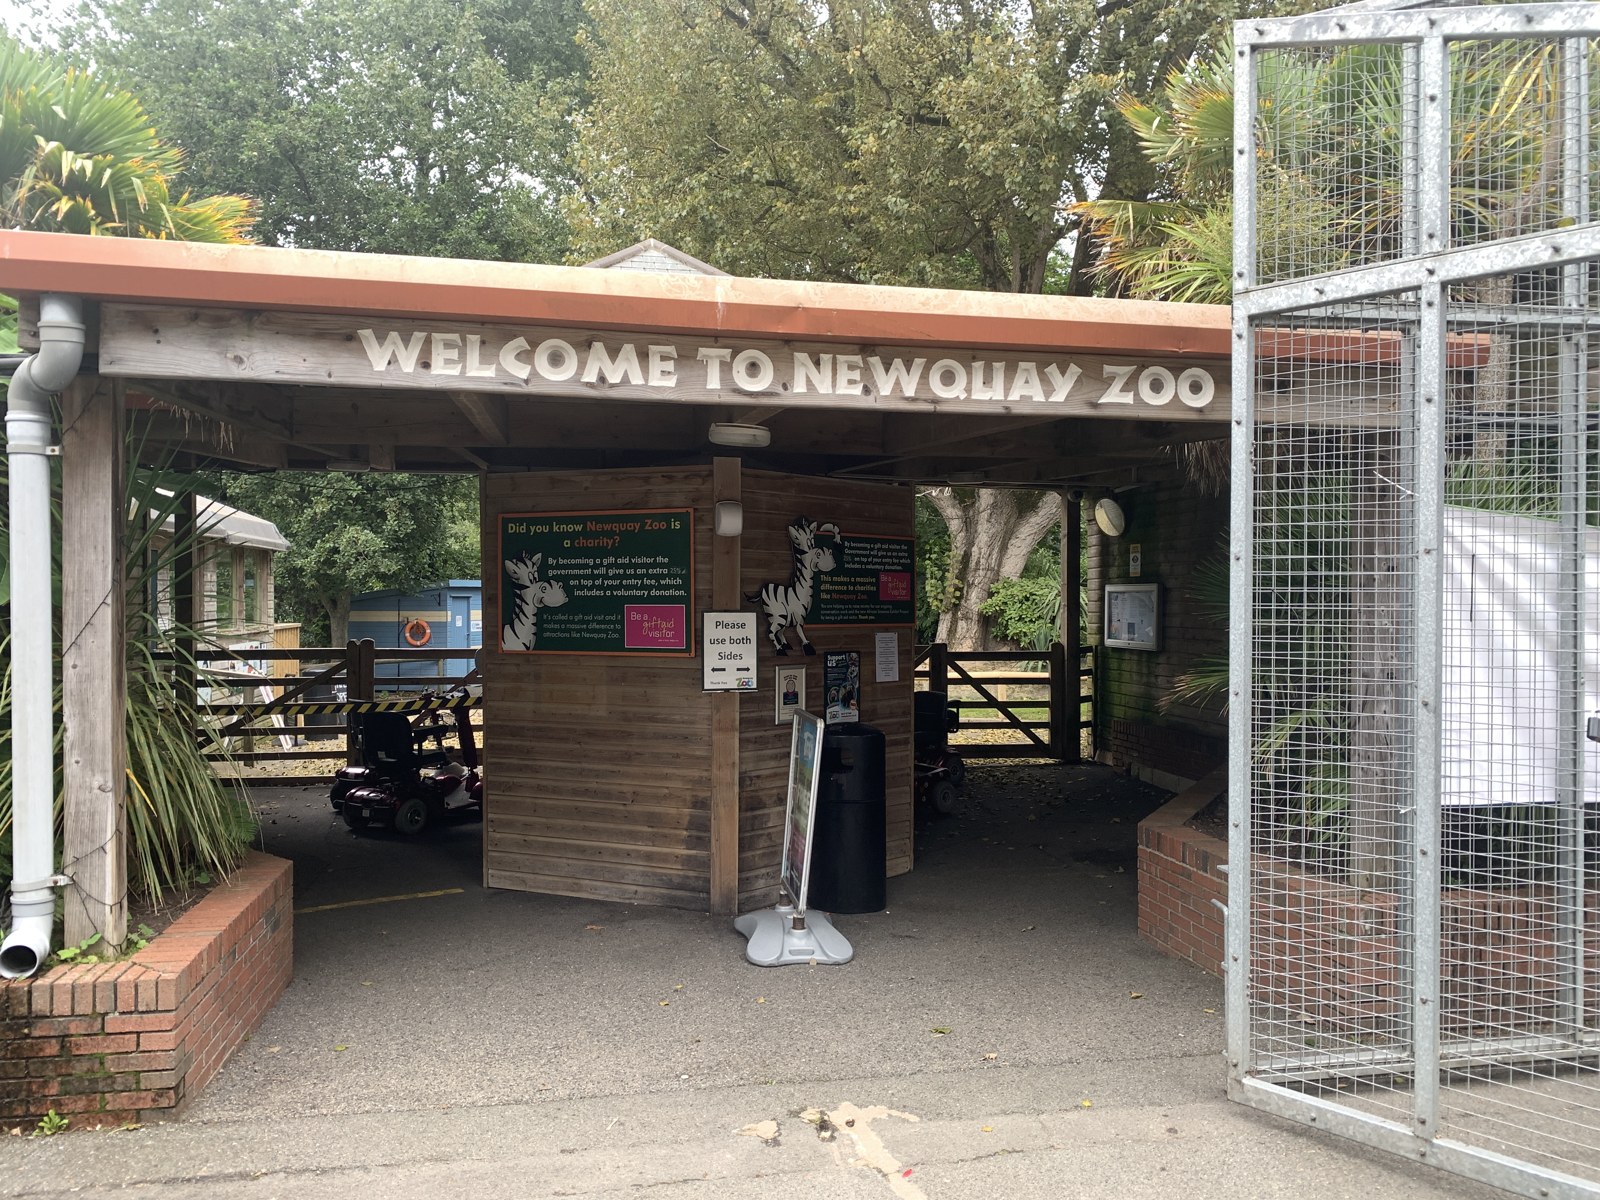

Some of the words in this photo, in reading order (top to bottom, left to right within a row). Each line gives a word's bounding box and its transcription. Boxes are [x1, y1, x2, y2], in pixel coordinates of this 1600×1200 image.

[357, 329, 678, 387] WELCOME
[697, 347, 774, 392] TO
[793, 352, 1082, 403] NEWQUAY
[1098, 365, 1215, 407] ZOO
[508, 523, 526, 534] Did
[530, 525, 549, 535] you
[553, 522, 582, 533] know
[587, 521, 640, 532] Newquay
[645, 520, 666, 530] Zoo
[671, 518, 680, 528] is
[575, 536, 620, 549] charity?
[548, 557, 556, 565] By
[559, 557, 593, 566] becoming
[603, 556, 615, 565] gift
[548, 568, 591, 576] government
[608, 567, 624, 576] give
[581, 578, 592, 586] top
[623, 578, 641, 586] entry
[644, 578, 658, 586] fee,
[613, 589, 648, 598] voluntary
[574, 614, 583, 622] gift
[631, 612, 641, 620] Be
[716, 621, 746, 629] Please
[648, 627, 675, 638] visitor
[729, 636, 751, 644] both
[718, 652, 743, 660] Sides
